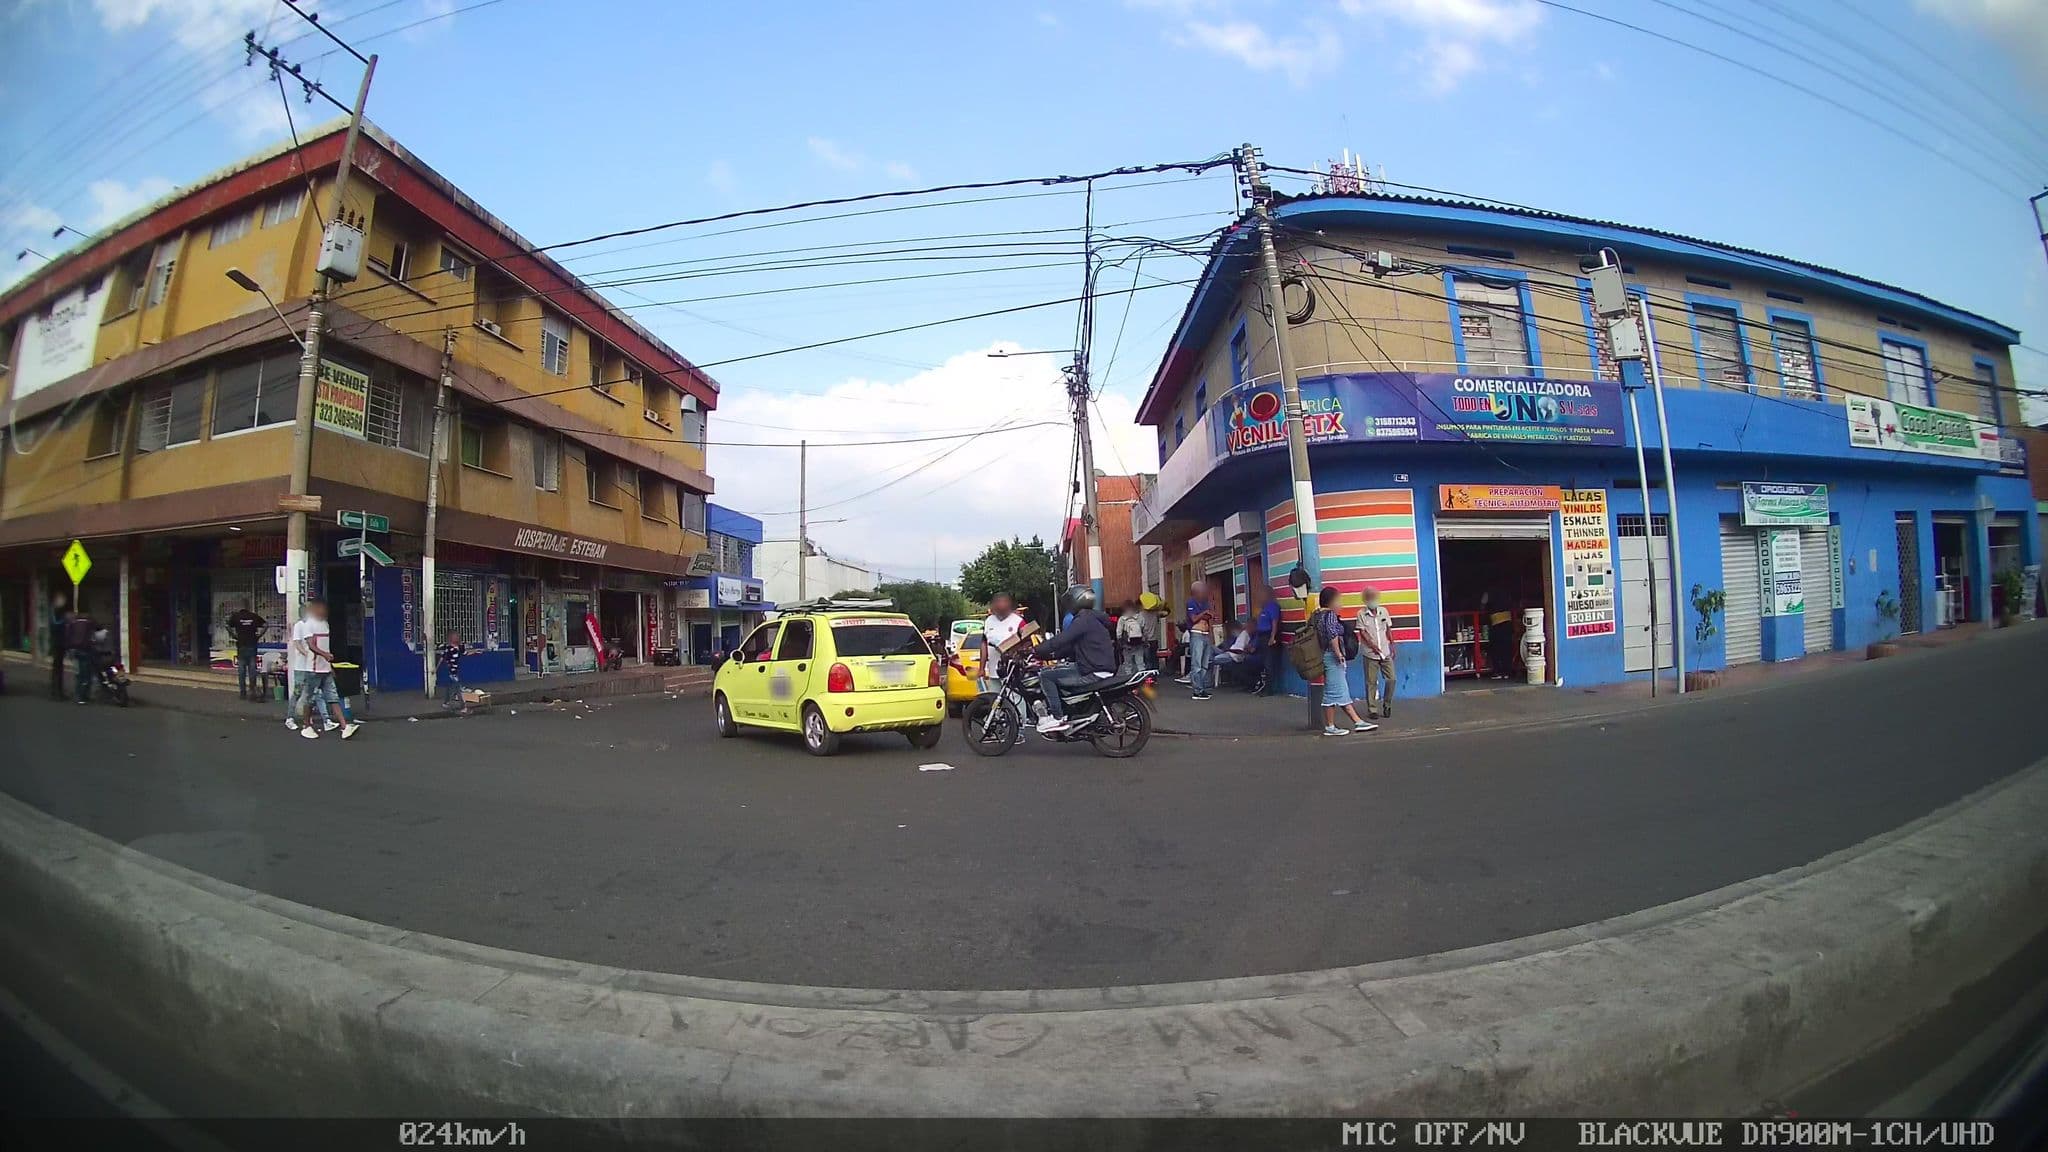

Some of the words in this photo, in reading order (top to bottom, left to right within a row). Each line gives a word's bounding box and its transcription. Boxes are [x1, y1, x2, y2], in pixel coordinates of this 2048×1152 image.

[333, 369, 367, 392] VENDE
[1454, 379, 1592, 398] COMERCIALIZADORA
[1452, 396, 1477, 412] TODO
[1479, 397, 1492, 411] EN
[1466, 424, 1481, 432] PARA
[1482, 424, 1511, 432] PINTURAS
[1573, 427, 1590, 436] PASTA
[1760, 485, 1806, 494] DROGUERIA
[1564, 491, 1601, 503] LACAS
[1509, 499, 1560, 508] AUTOMOTRIZ
[1564, 503, 1602, 514] VINILOS
[1563, 515, 1601, 526] ESMALTE
[1565, 527, 1605, 538] THINNER
[514, 527, 568, 553] HOSPEDAJE
[570, 538, 607, 559] ESTEBAN
[1566, 539, 1604, 550] MADERA
[1573, 551, 1604, 560] LIJAS
[1760, 530, 1771, 614] DROGUERIA
[1571, 589, 1601, 599] PASTA
[1567, 599, 1594, 611] HUESO
[1571, 611, 1605, 623] ROBIN
[1571, 622, 1611, 636] MALLAS
